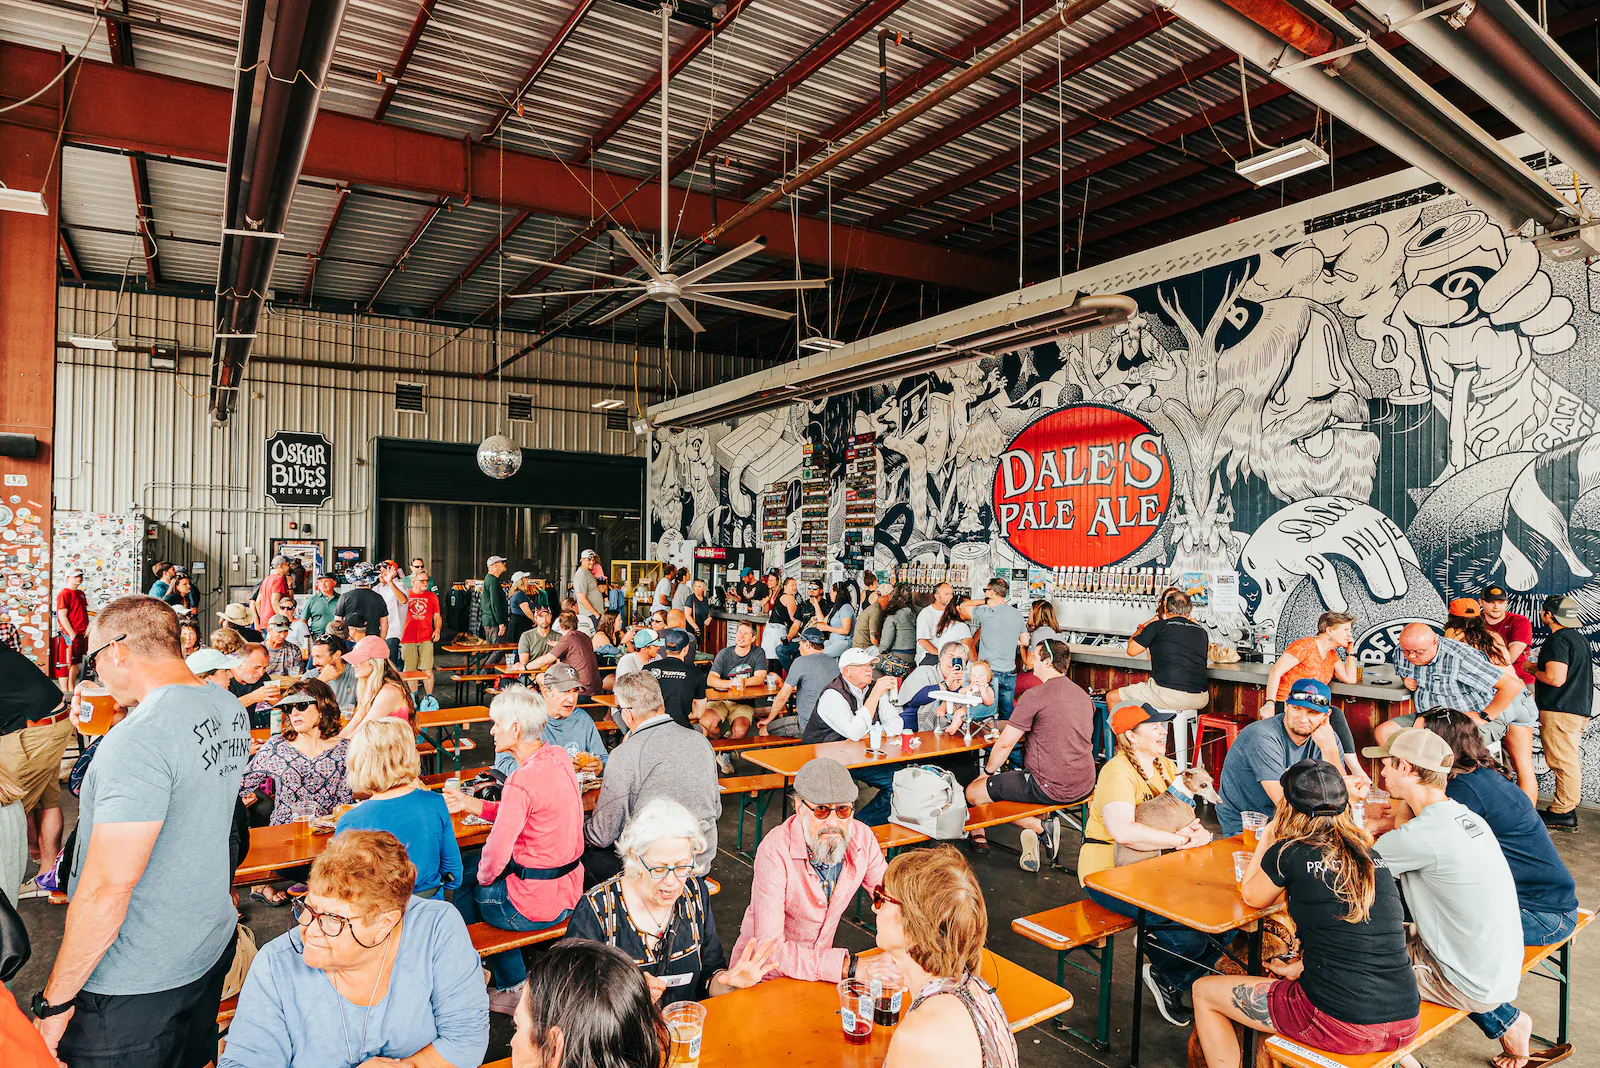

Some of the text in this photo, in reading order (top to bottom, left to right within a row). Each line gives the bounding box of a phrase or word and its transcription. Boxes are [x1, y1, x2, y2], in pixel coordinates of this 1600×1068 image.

[271, 439, 327, 466] OSKAR
[999, 433, 1163, 499] DALE'S
[271, 463, 327, 488] BLUES
[271, 487, 327, 495] BREWERY
[998, 493, 1163, 538] PALE ALE
[1360, 625, 1404, 663] BEE
